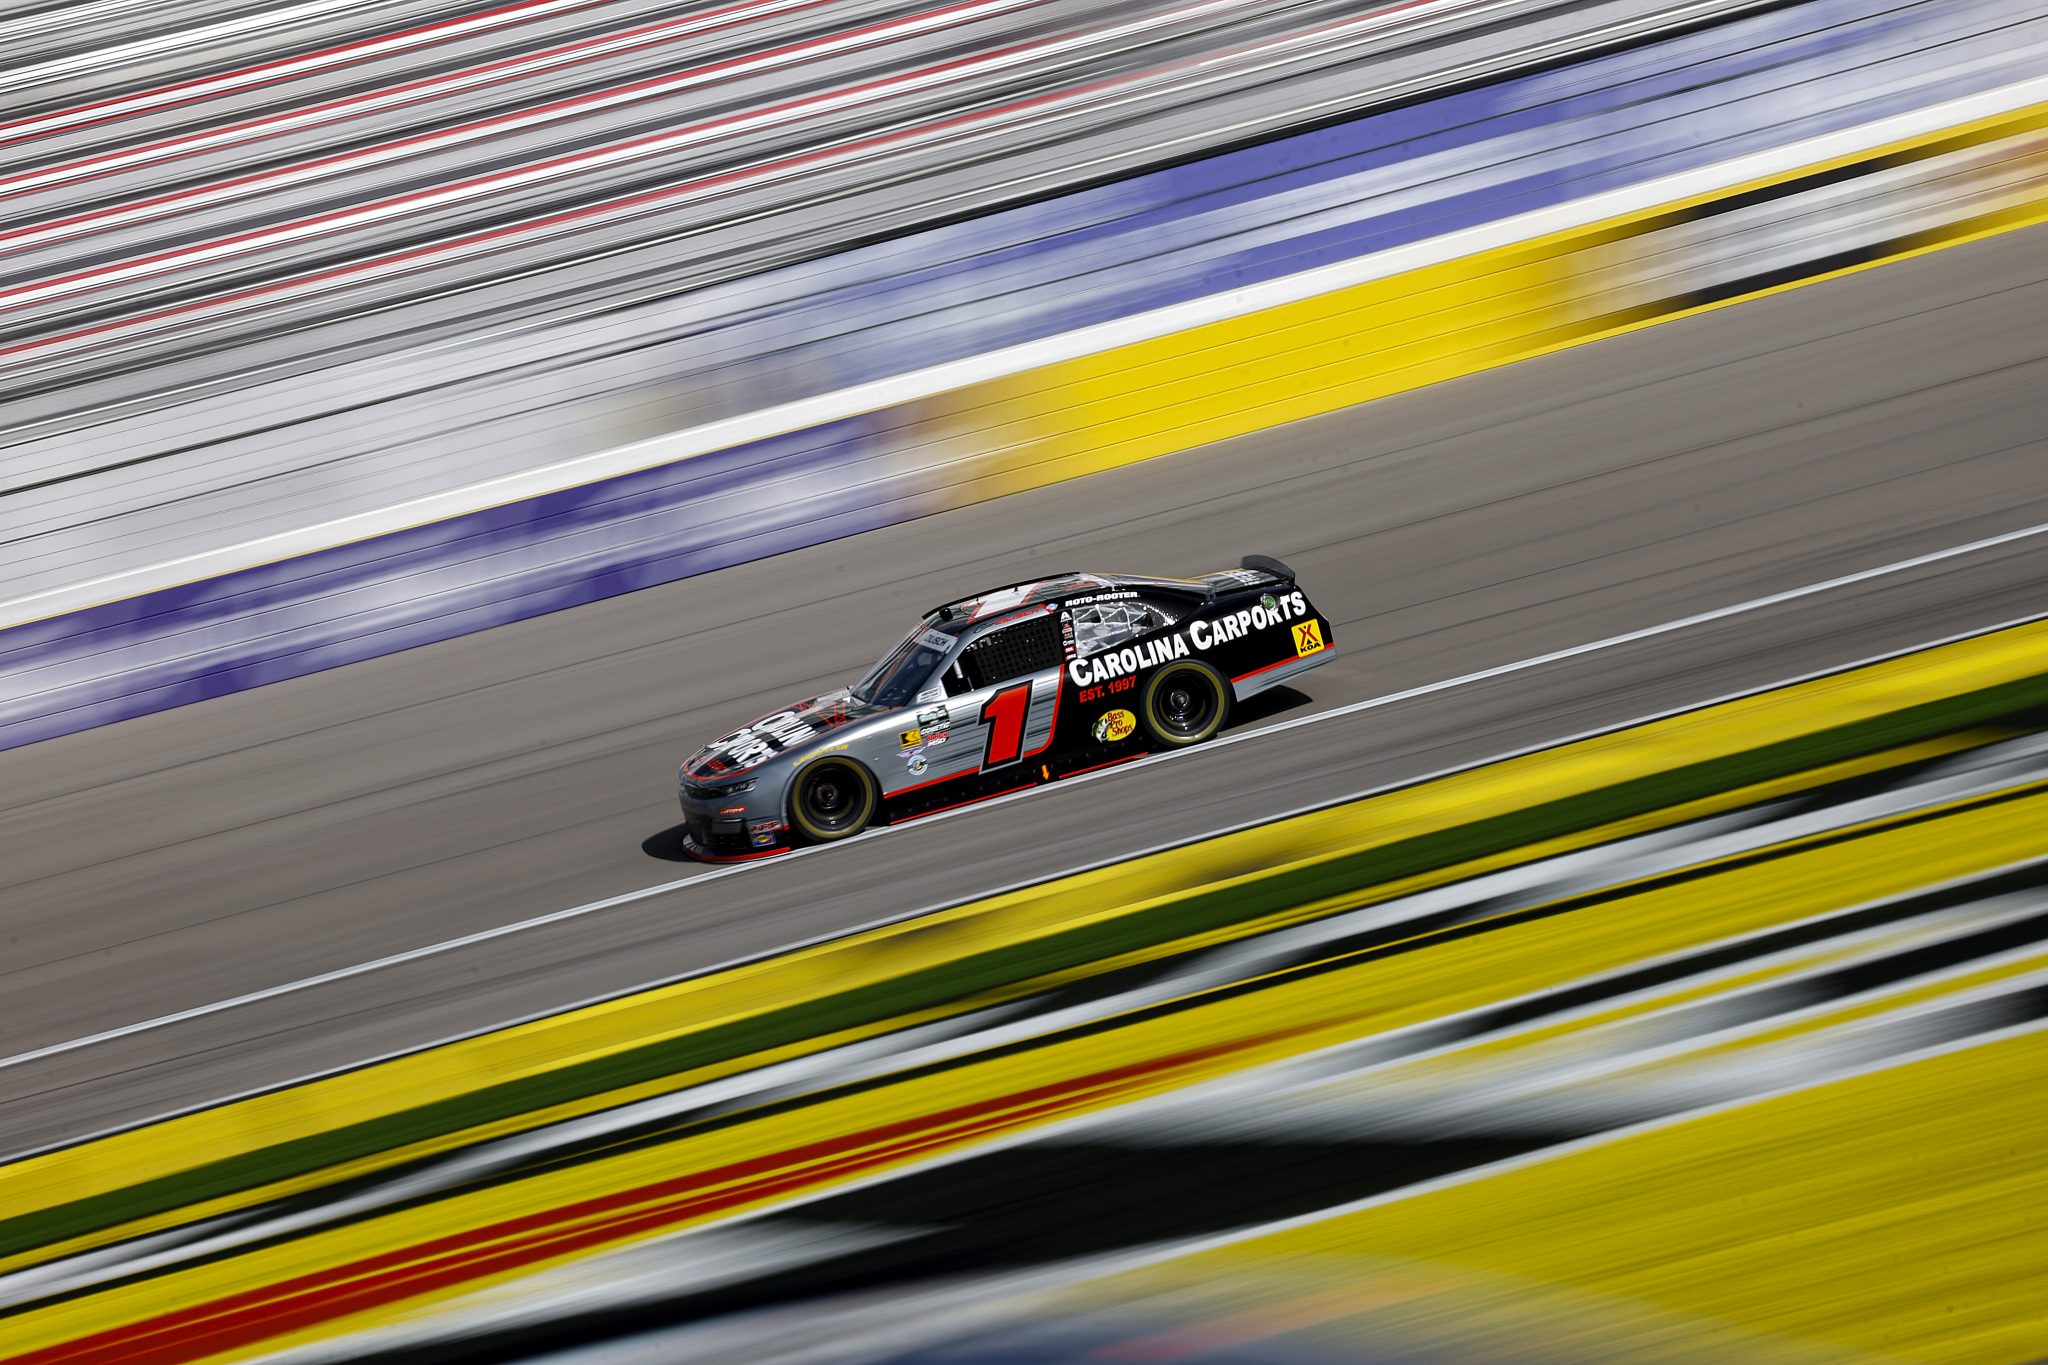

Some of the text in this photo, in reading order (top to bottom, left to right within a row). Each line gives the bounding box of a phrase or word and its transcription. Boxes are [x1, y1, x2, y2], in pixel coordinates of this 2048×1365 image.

[1065, 591, 1138, 607] ROTO-ROOTER
[1068, 591, 1306, 687] CAROLINA CARPORTS
[1300, 642, 1321, 654] KOA
[1079, 675, 1137, 703] EST. 1997
[1108, 711, 1124, 721] Bass
[979, 680, 1032, 772] 1
[1110, 719, 1123, 729] Pro
[1112, 725, 1133, 736] Shops
